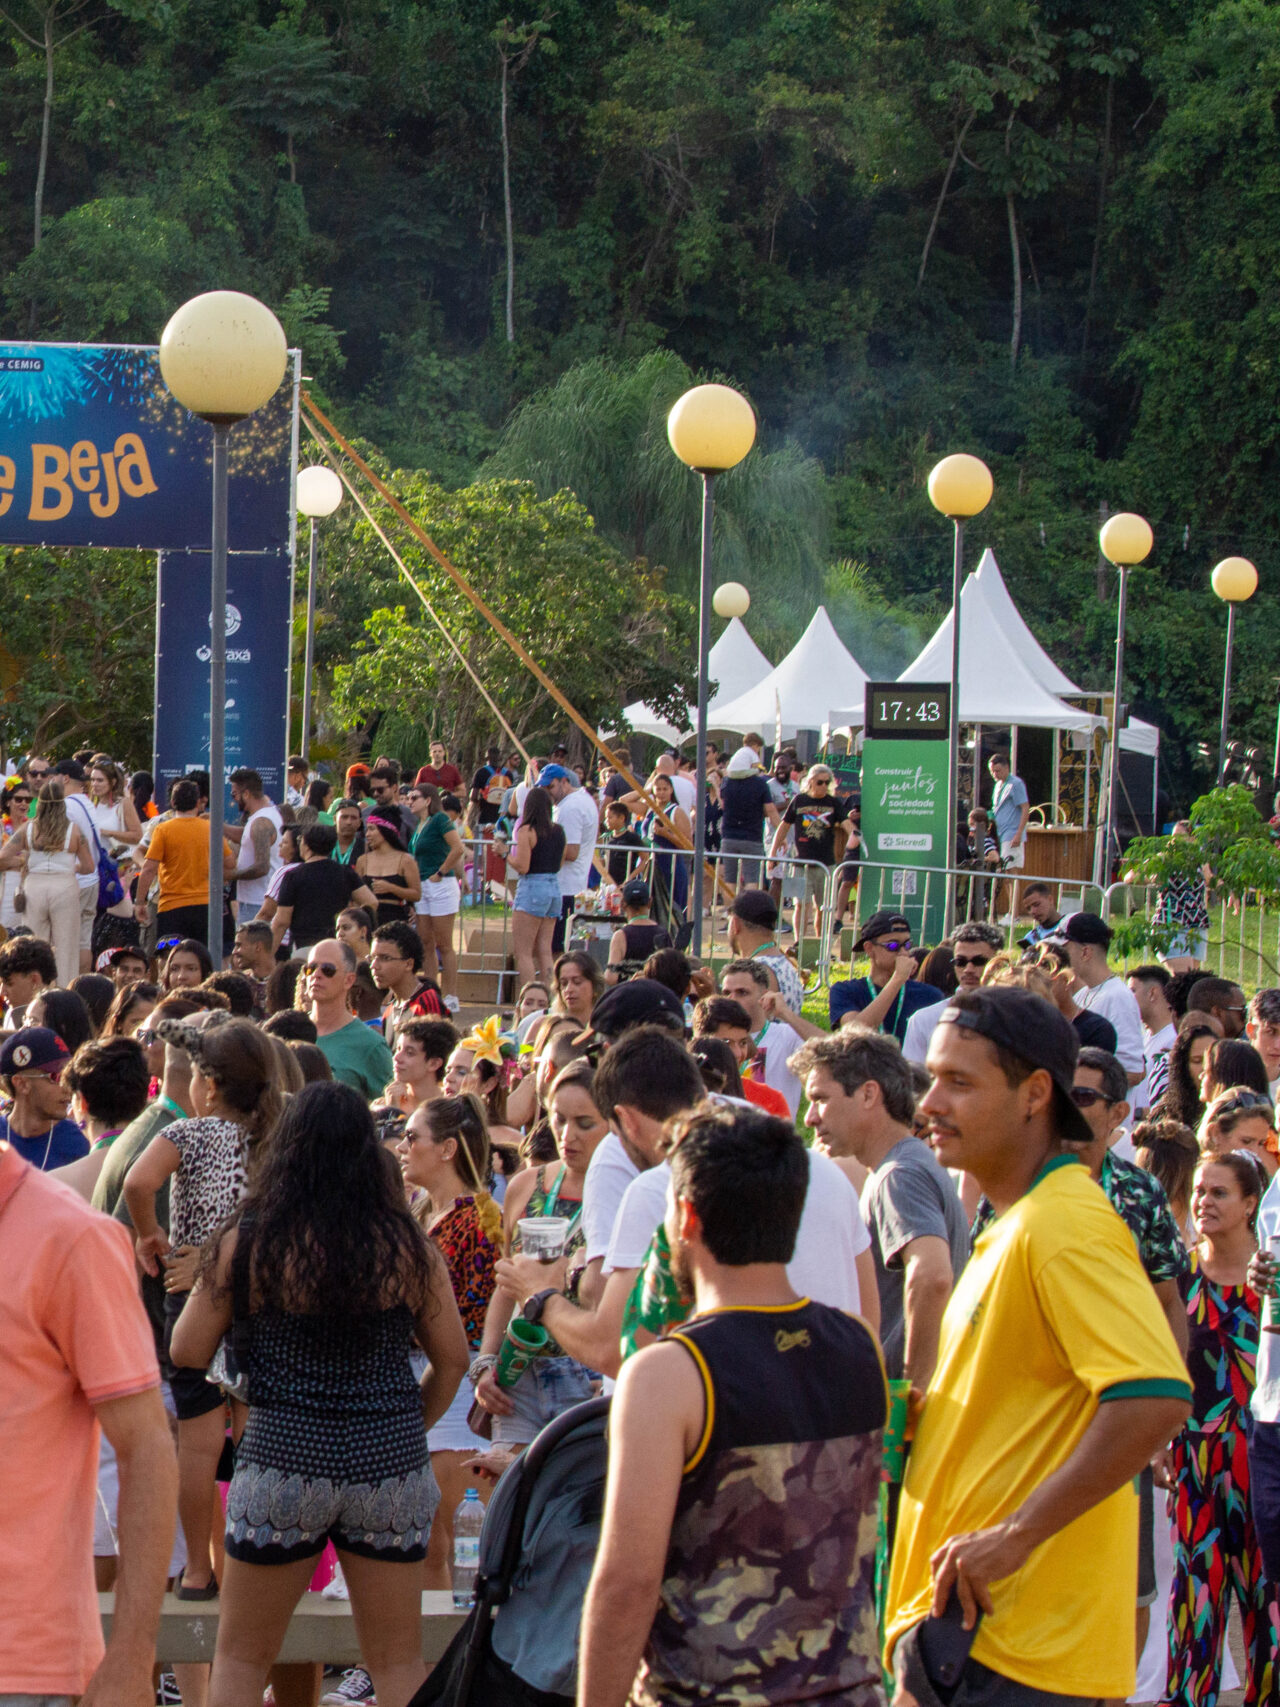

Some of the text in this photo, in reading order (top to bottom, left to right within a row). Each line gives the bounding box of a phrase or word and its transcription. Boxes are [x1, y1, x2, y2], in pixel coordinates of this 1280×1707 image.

[7, 360, 41, 370] CEMIG
[880, 701, 941, 722] 17:43
[875, 767, 914, 775] Construir
[880, 765, 939, 807] juntos
[888, 799, 935, 808] sociedade
[895, 836, 926, 847] Sicredi
